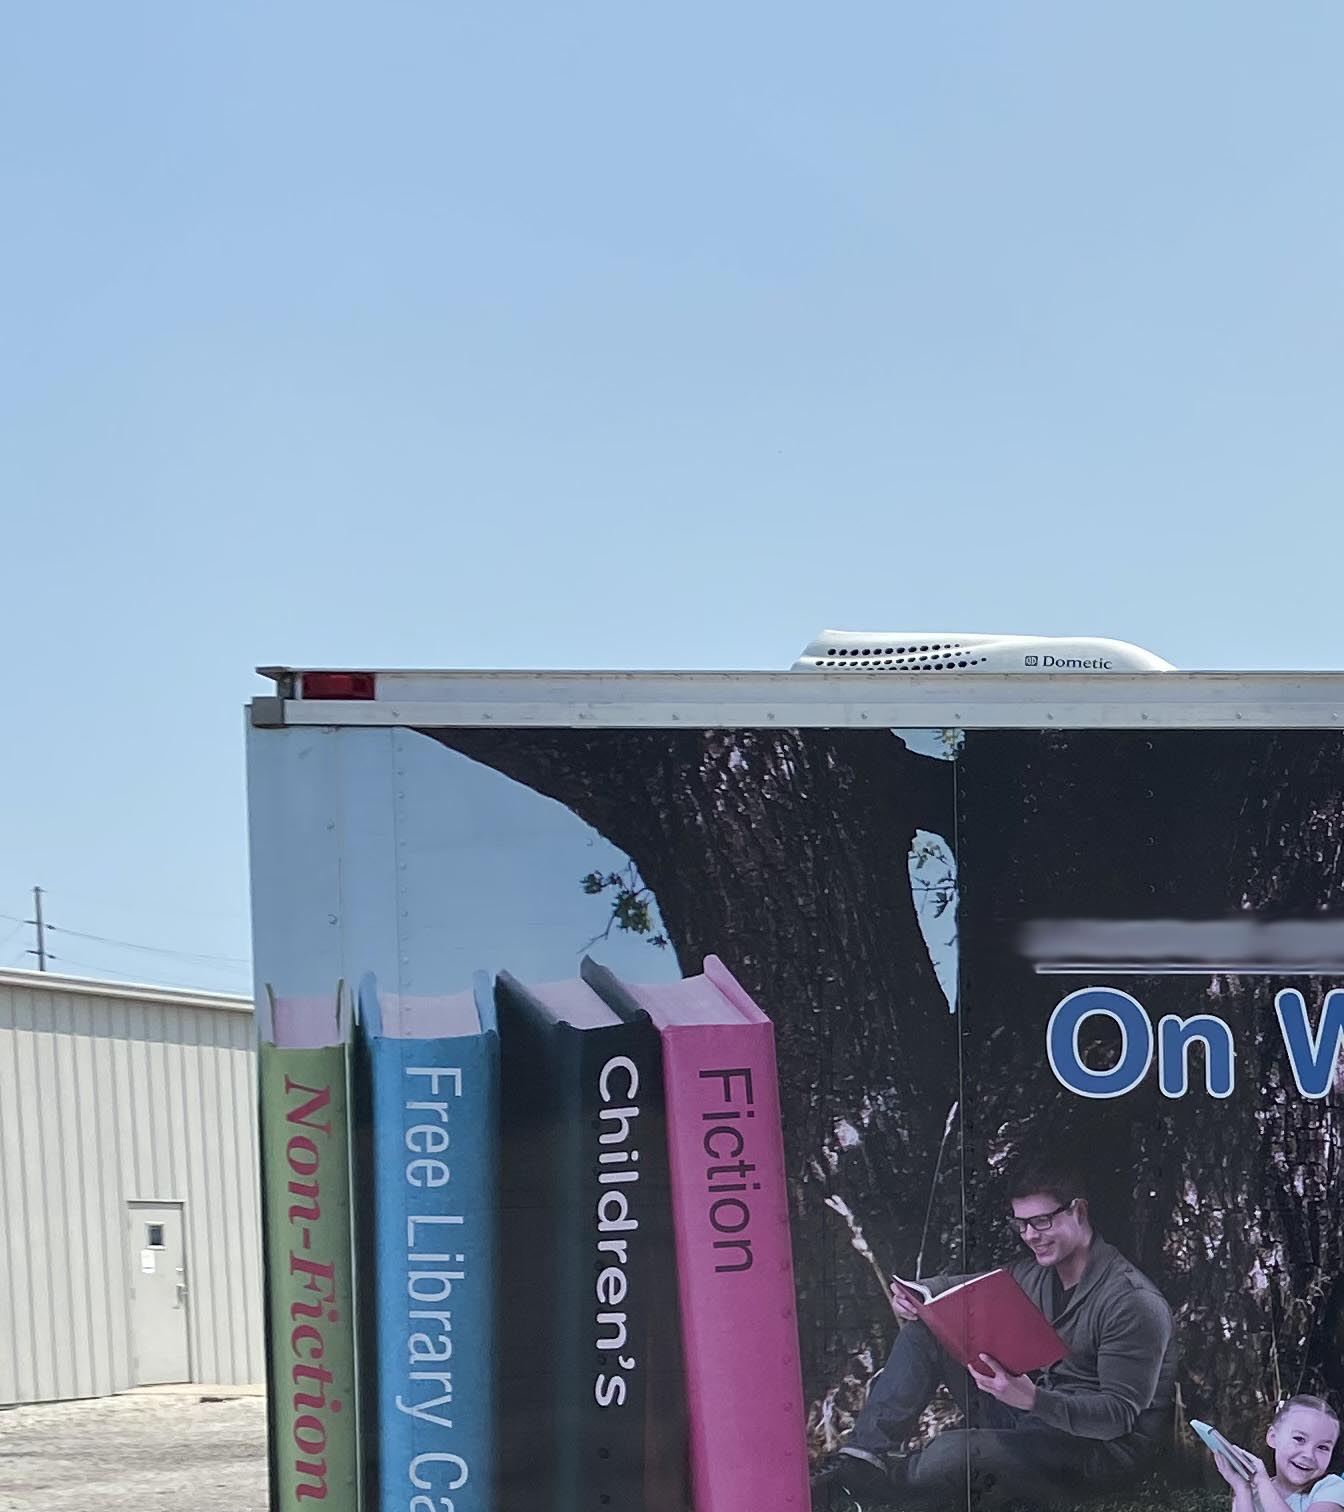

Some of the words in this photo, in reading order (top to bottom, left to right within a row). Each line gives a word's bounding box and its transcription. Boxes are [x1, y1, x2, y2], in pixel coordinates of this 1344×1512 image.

[1043, 655, 1112, 669] Dometic
[404, 1066, 462, 1189] Free
[1047, 986, 1234, 1099] On
[594, 1055, 640, 1407] Children's
[699, 1066, 760, 1273] Fiction
[283, 1074, 339, 1501] Non-Fiction
[396, 1215, 465, 1429] Library
